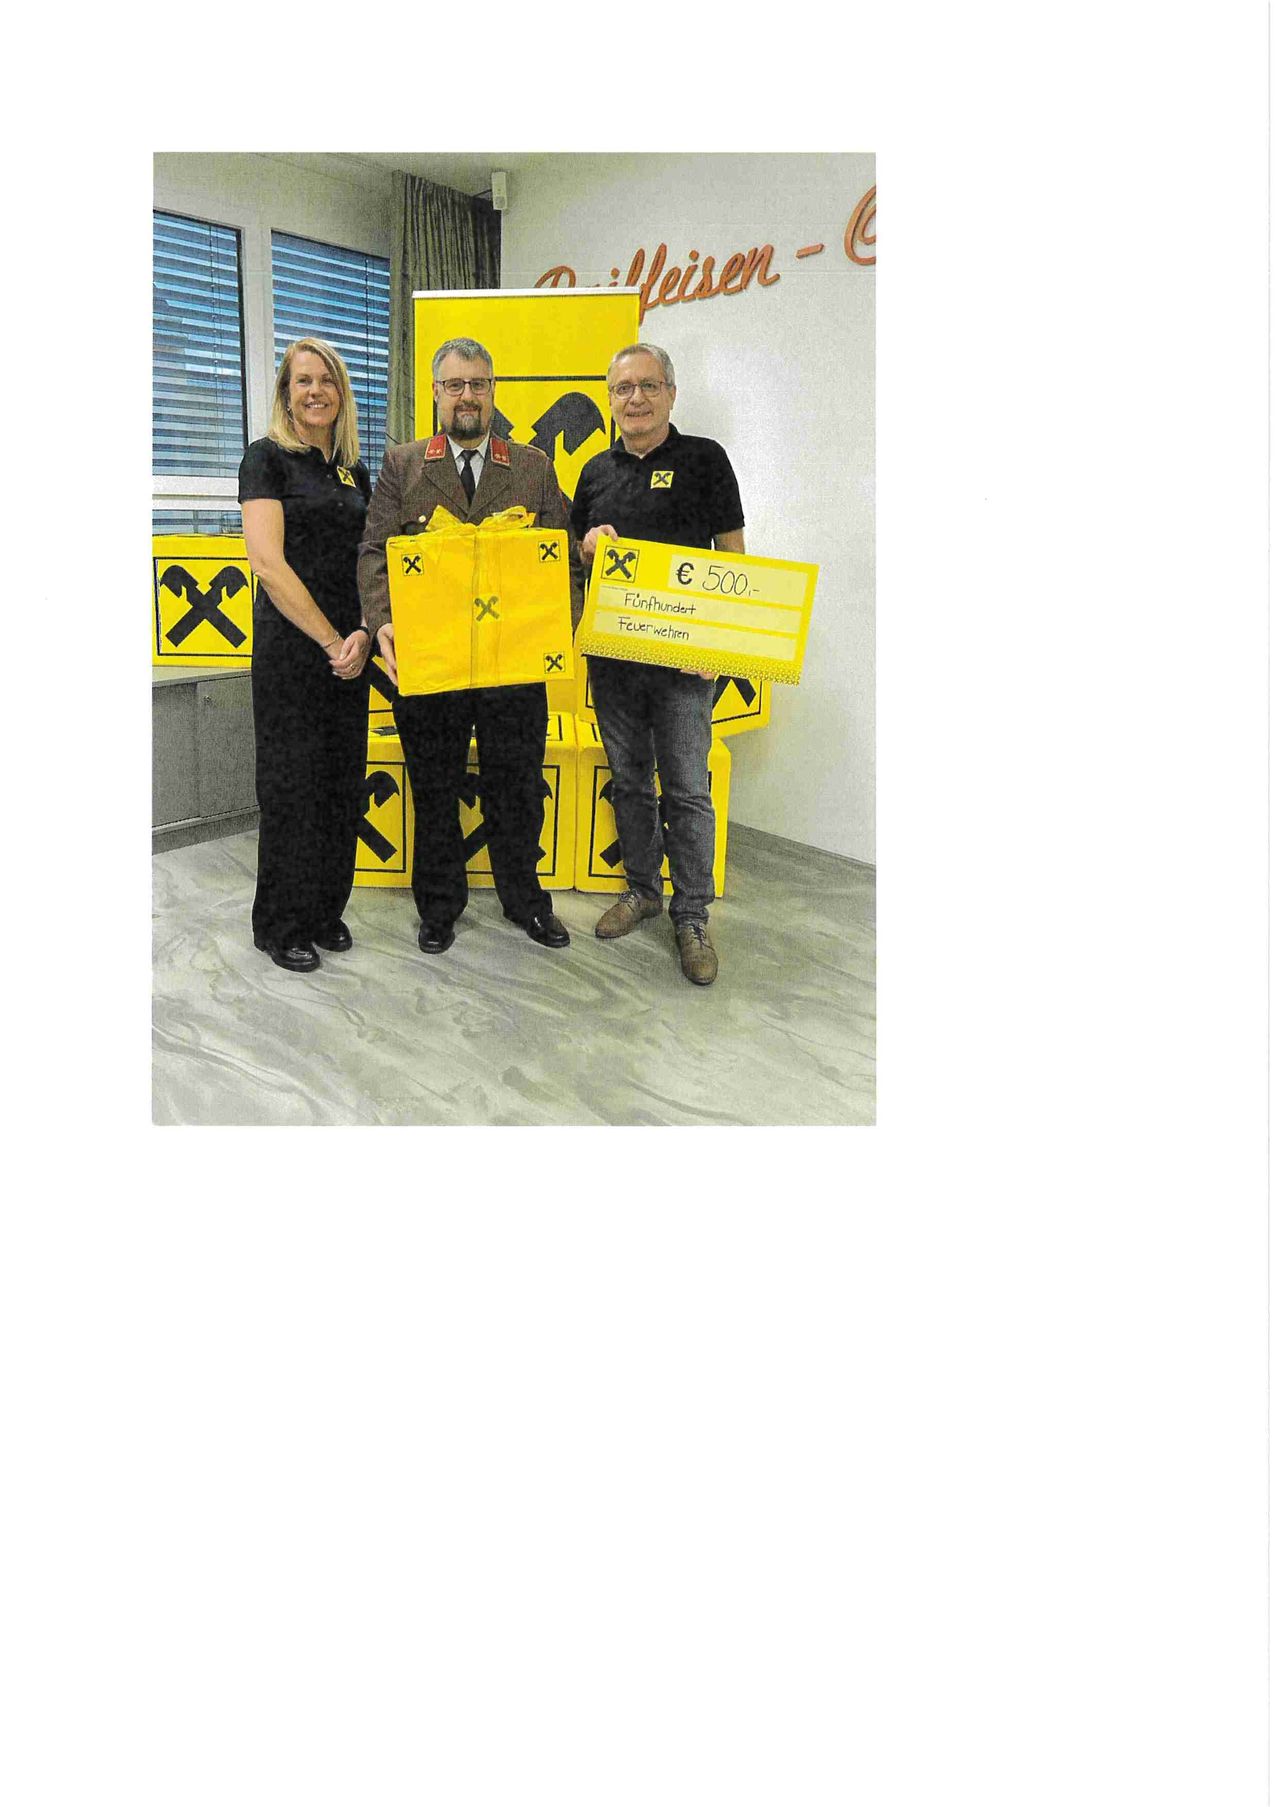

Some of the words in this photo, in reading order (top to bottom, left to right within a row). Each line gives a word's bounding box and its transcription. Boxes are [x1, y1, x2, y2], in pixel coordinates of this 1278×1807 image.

[675, 561, 695, 586] €
[702, 564, 760, 597] 500,-
[624, 592, 697, 615] Fünfhundert
[617, 615, 690, 640] Feuerwehren
